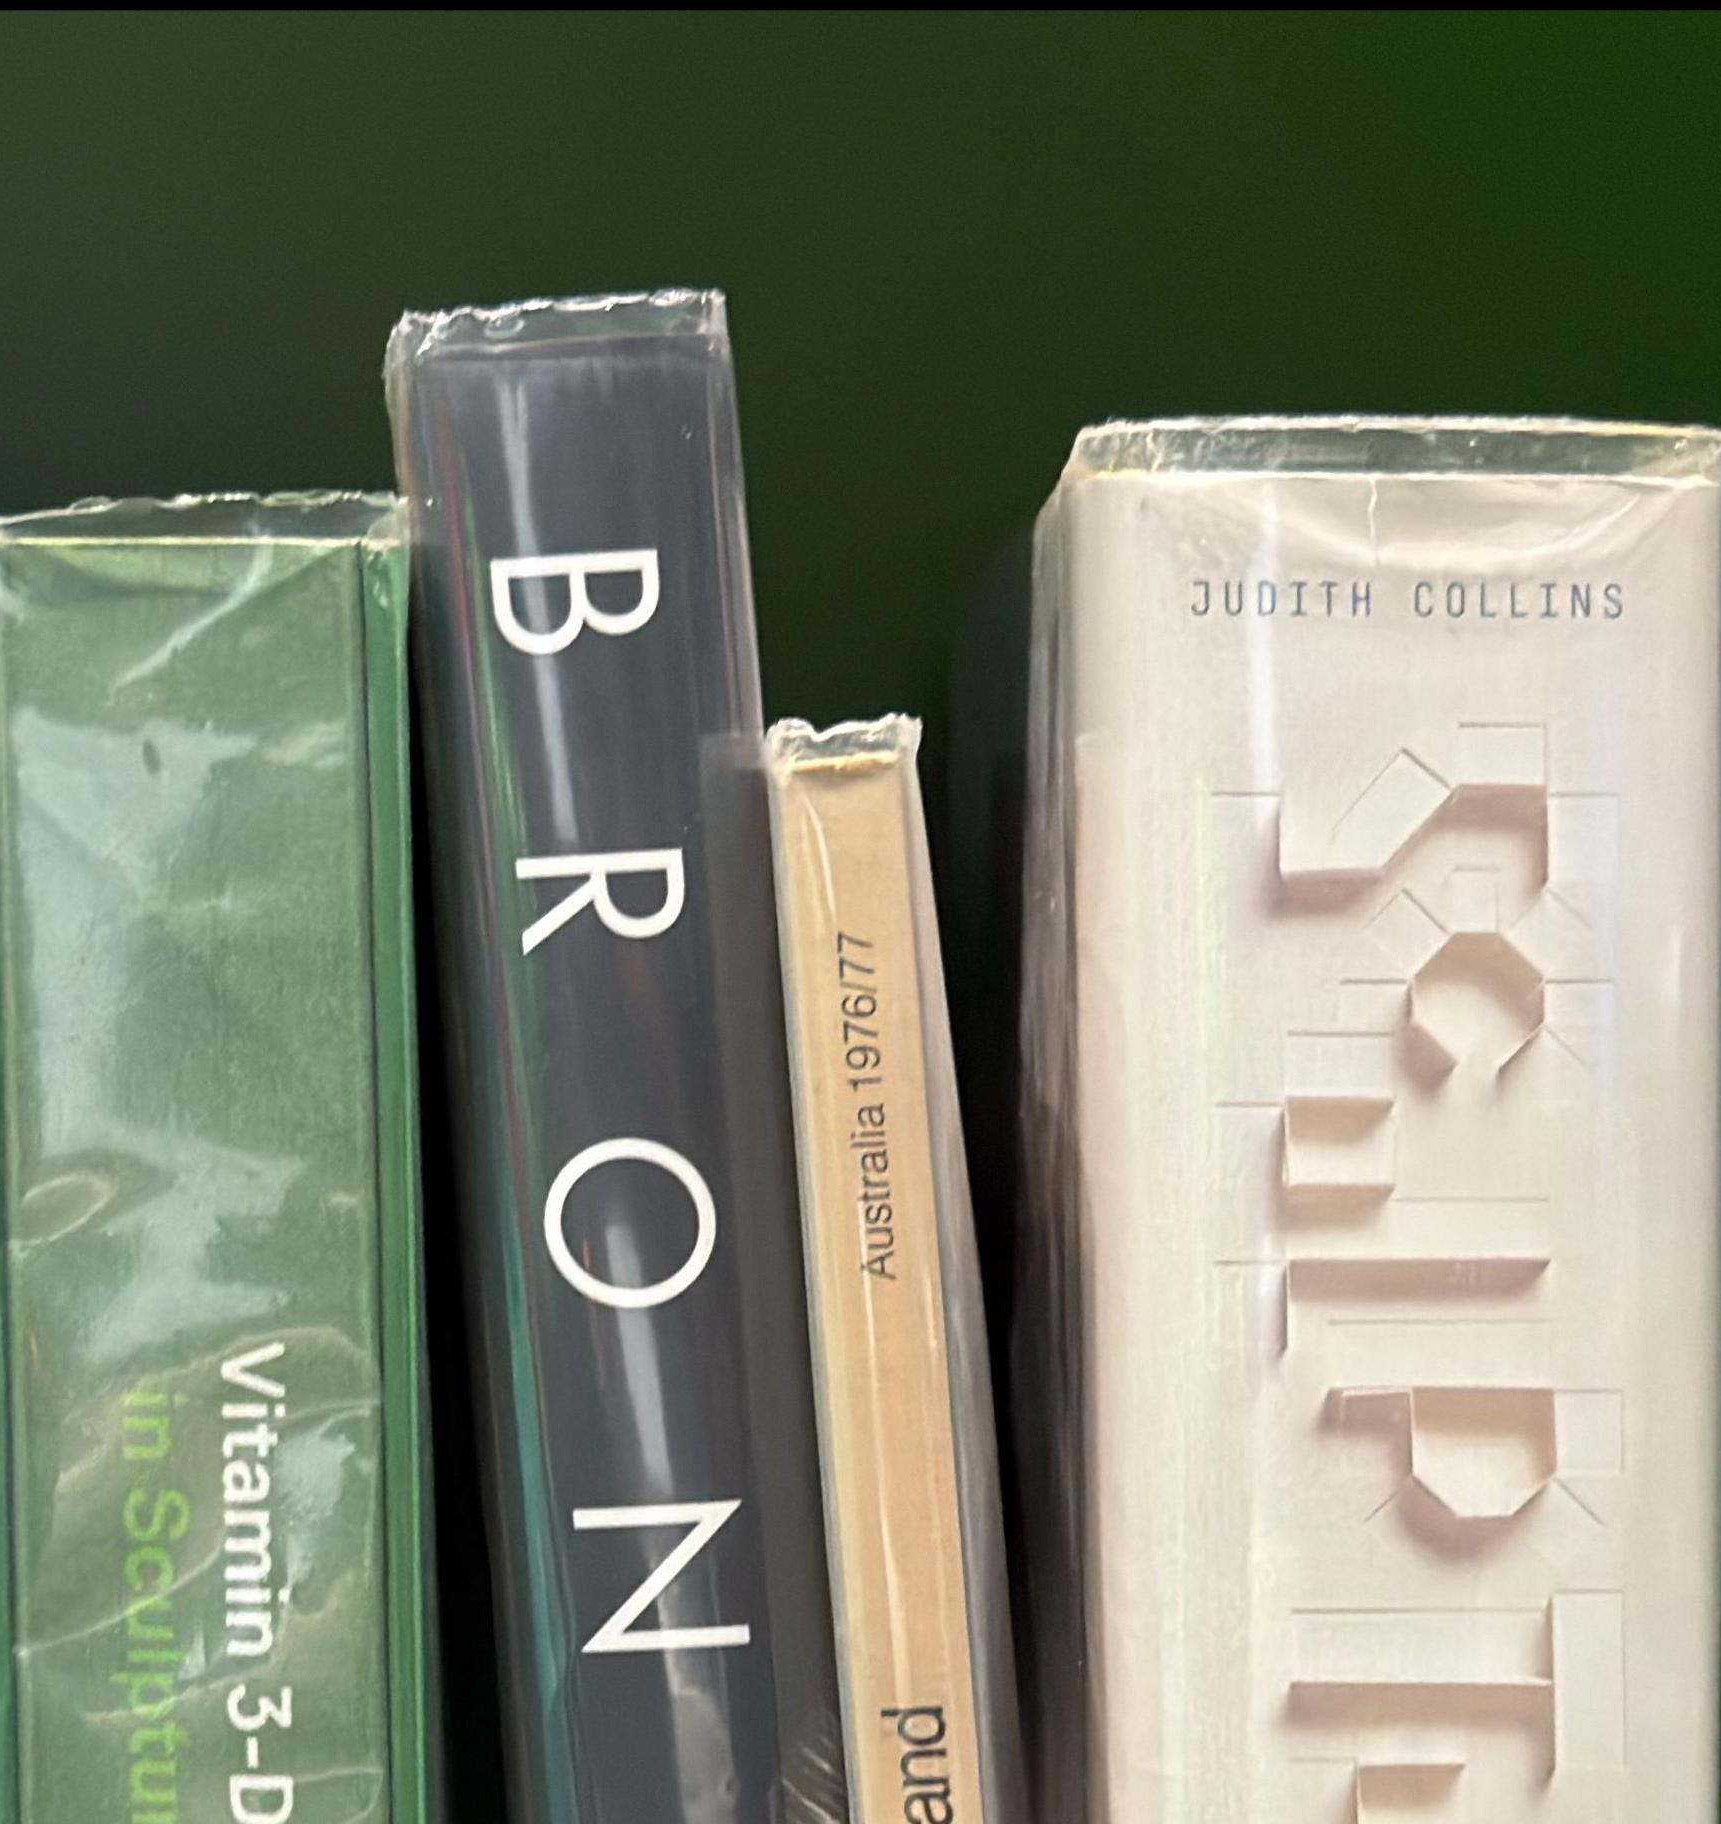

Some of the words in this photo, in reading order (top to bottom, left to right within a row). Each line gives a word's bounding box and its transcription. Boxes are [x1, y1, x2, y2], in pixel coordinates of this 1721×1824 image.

[1190, 578, 1374, 620] JUDITH
[1412, 579, 1626, 621] COLLINS
[836, 930, 884, 1096] 1976/77
[850, 1101, 897, 1283] Australia
[120, 1384, 190, 1463] in
[219, 1341, 295, 1660] Vitamin
